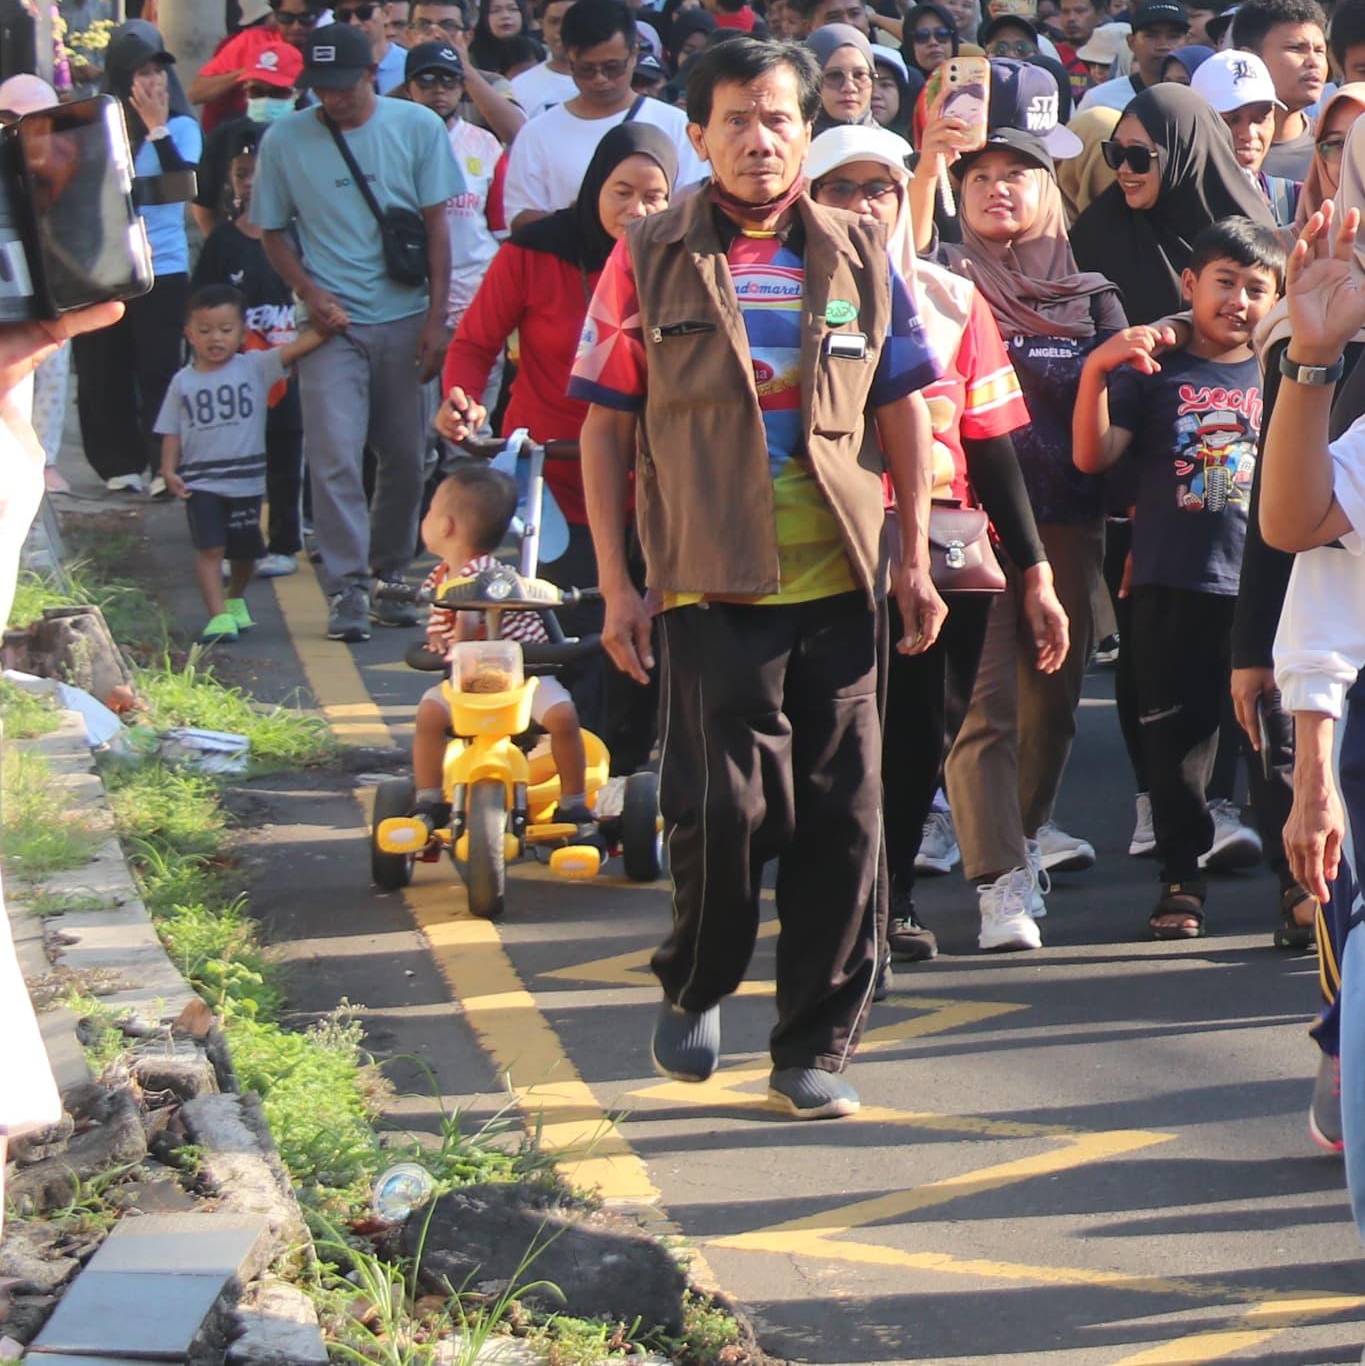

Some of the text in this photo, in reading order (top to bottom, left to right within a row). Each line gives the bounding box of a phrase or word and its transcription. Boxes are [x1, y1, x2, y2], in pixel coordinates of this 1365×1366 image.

[1028, 90, 1058, 113] STA
[1027, 112, 1059, 130] WA
[735, 281, 801, 295] ndomaret
[182, 382, 254, 428] 1896
